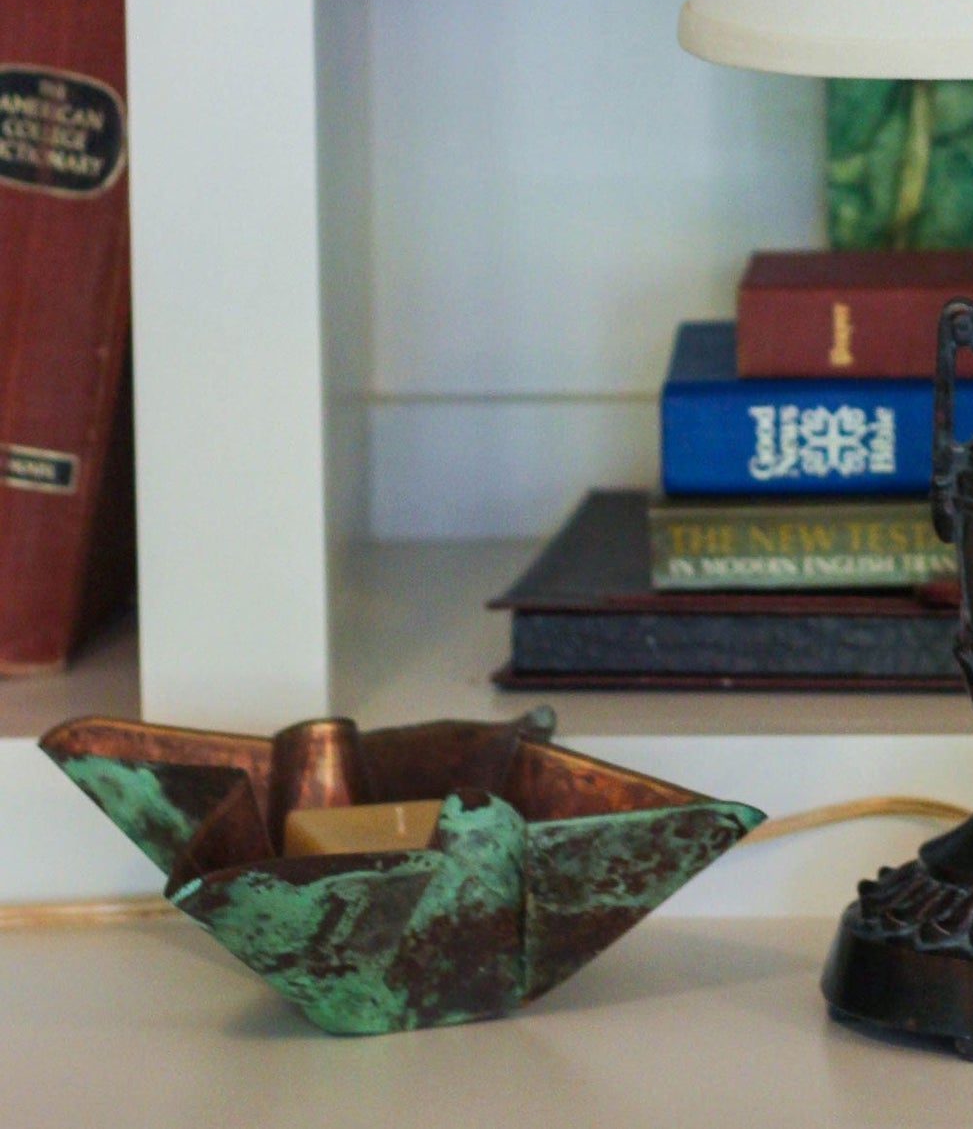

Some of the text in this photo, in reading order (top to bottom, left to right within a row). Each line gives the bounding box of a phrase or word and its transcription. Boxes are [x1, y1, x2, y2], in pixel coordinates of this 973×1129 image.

[748, 404, 777, 482] Good
[773, 404, 801, 479] News
[867, 405, 896, 474] Bible
[668, 524, 733, 553] THE
[749, 522, 834, 553] NEW
